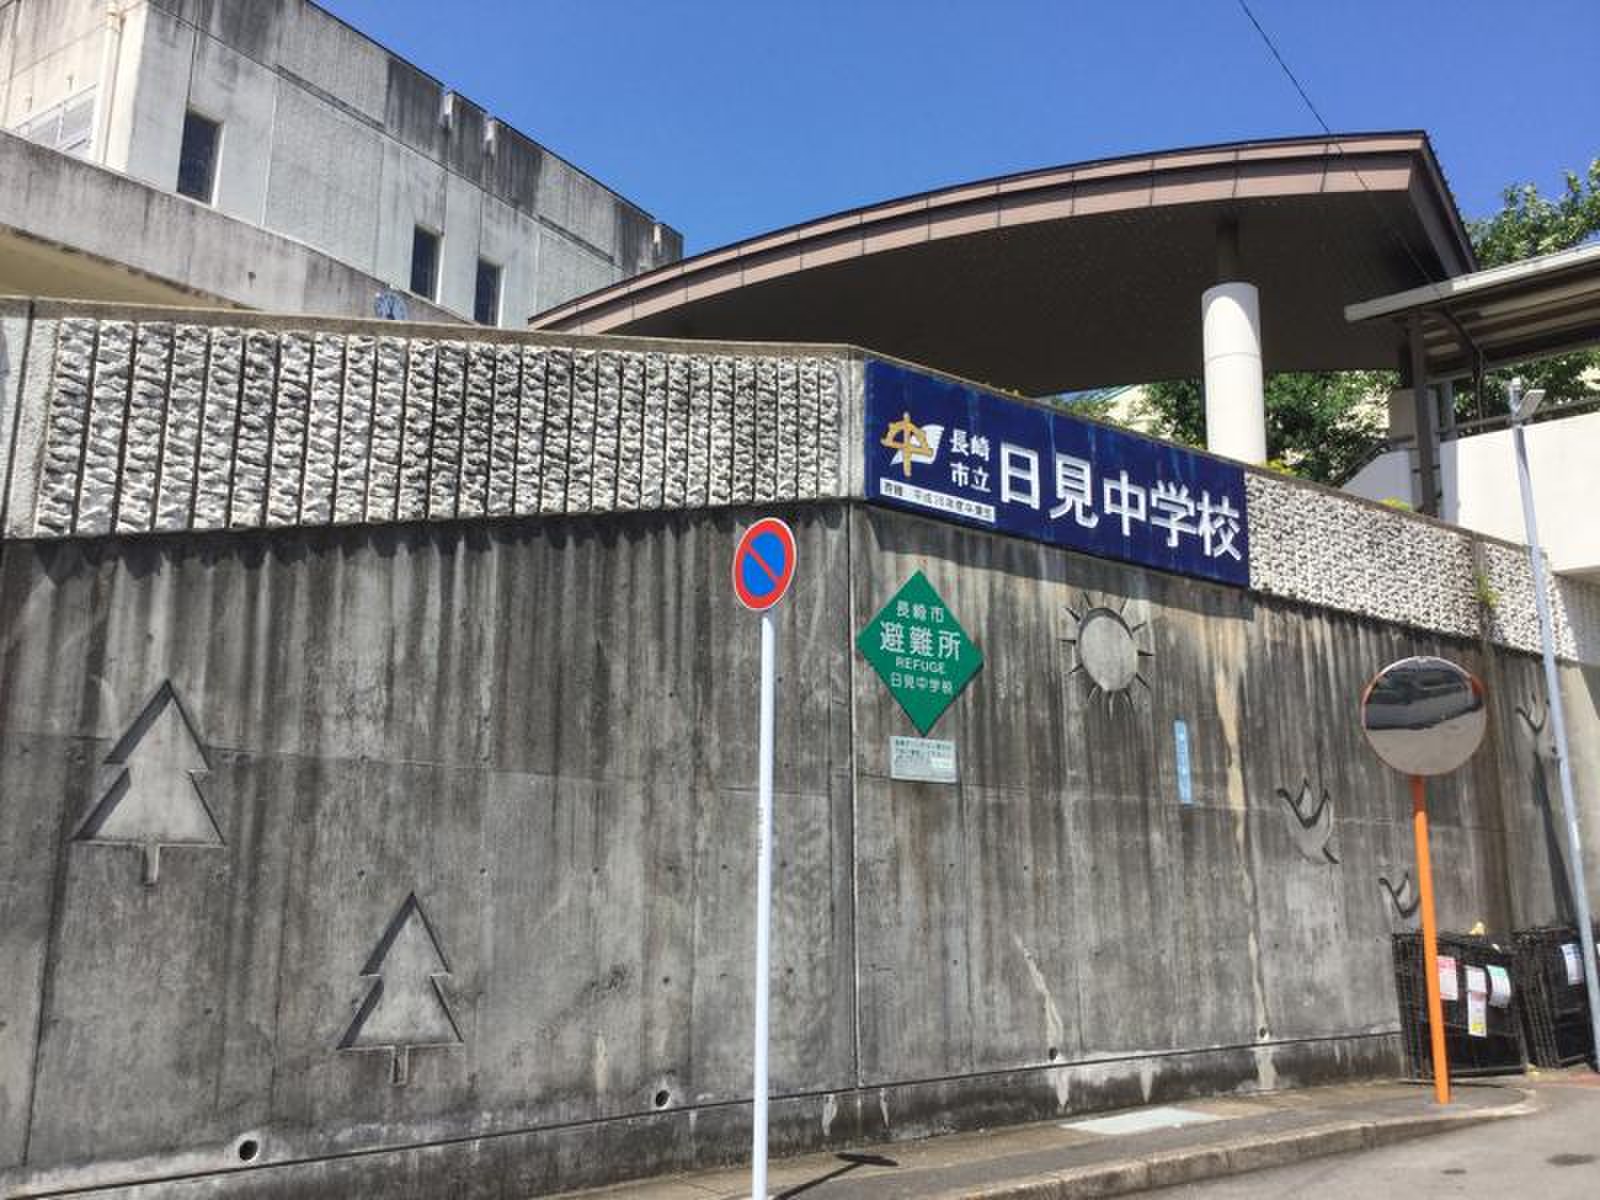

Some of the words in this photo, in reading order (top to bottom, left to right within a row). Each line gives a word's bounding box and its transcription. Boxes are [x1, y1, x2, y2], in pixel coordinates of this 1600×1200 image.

[949, 428, 992, 462] 長崎
[950, 461, 992, 494] 市立
[998, 441, 1243, 562] 日見中学校
[895, 600, 945, 624] 長崎市
[879, 620, 962, 661] 避難所
[895, 656, 946, 675] REFUGE
[890, 672, 954, 695] 日見中学校
